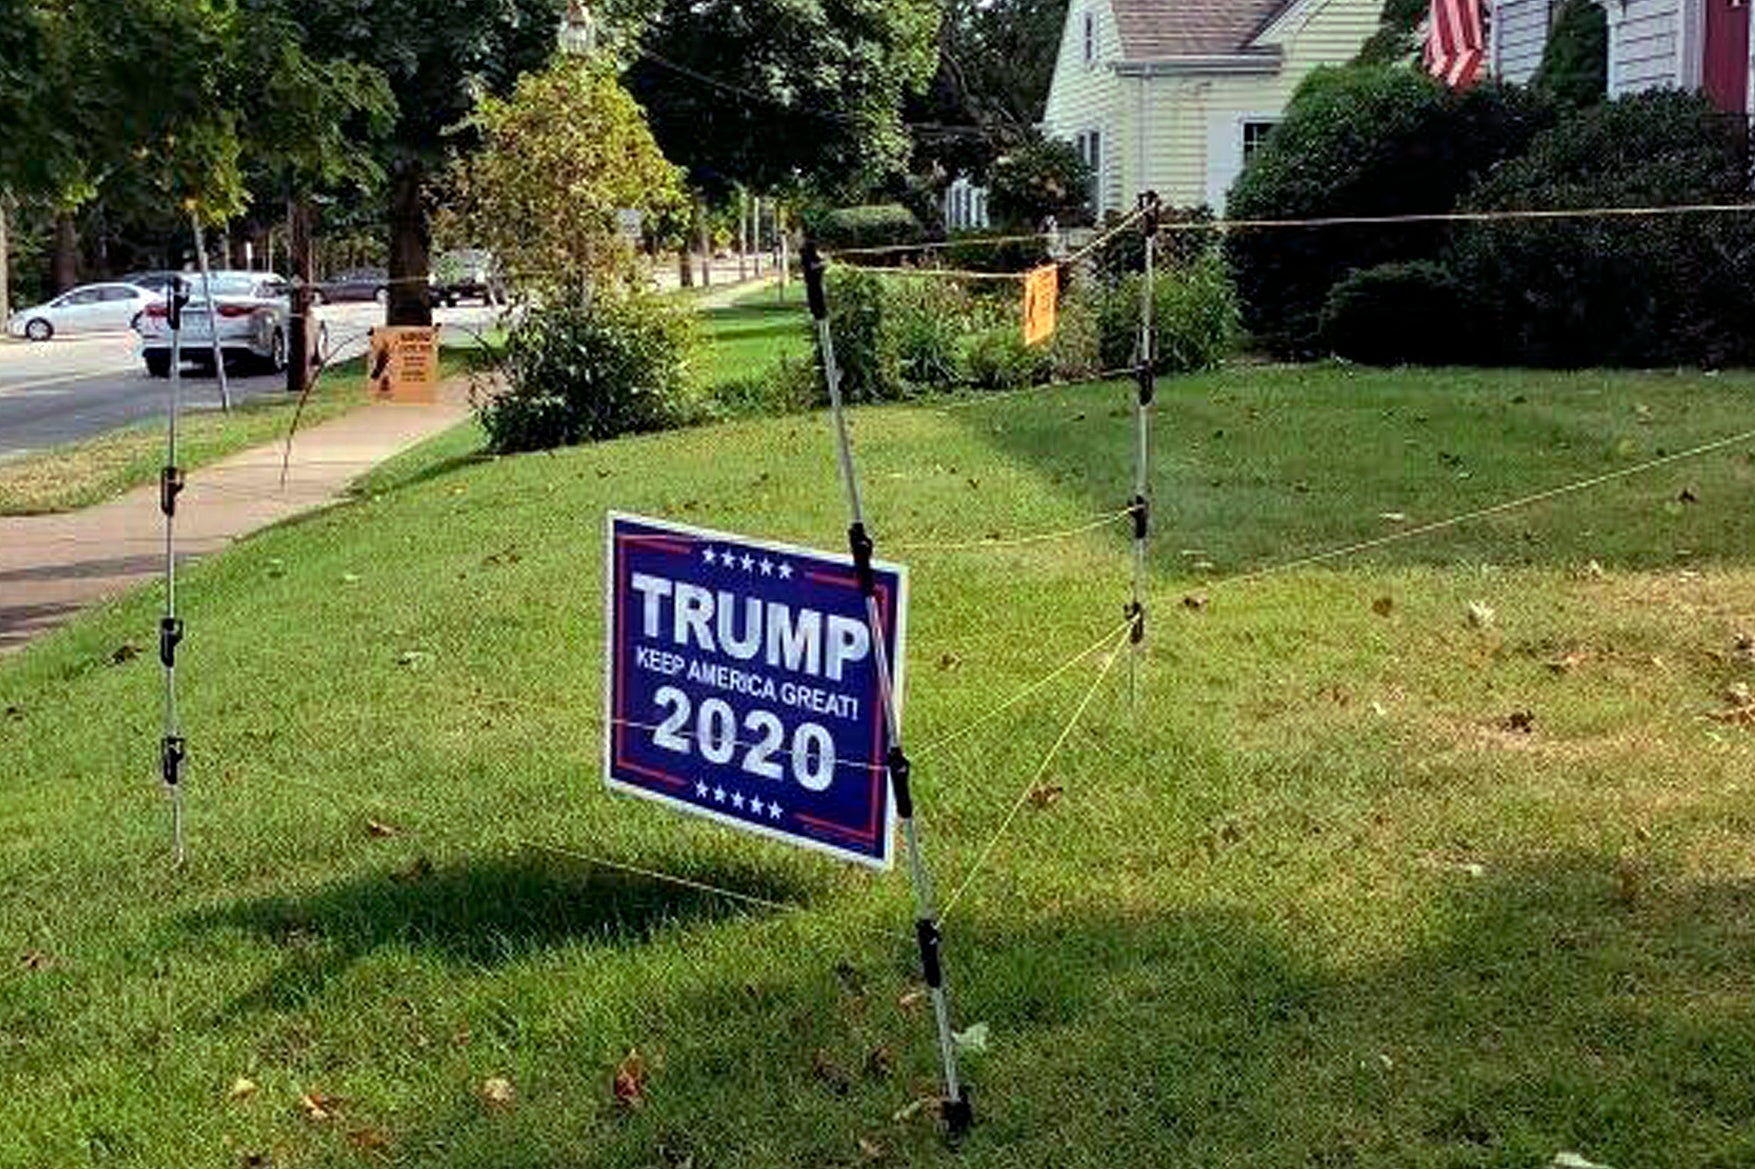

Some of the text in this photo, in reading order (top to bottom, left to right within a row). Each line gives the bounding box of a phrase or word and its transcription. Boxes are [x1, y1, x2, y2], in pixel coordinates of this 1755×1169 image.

[632, 573, 870, 681] TRUMP
[637, 646, 858, 721] KEEP AMERICA GREAT!
[653, 686, 836, 792] 2020
